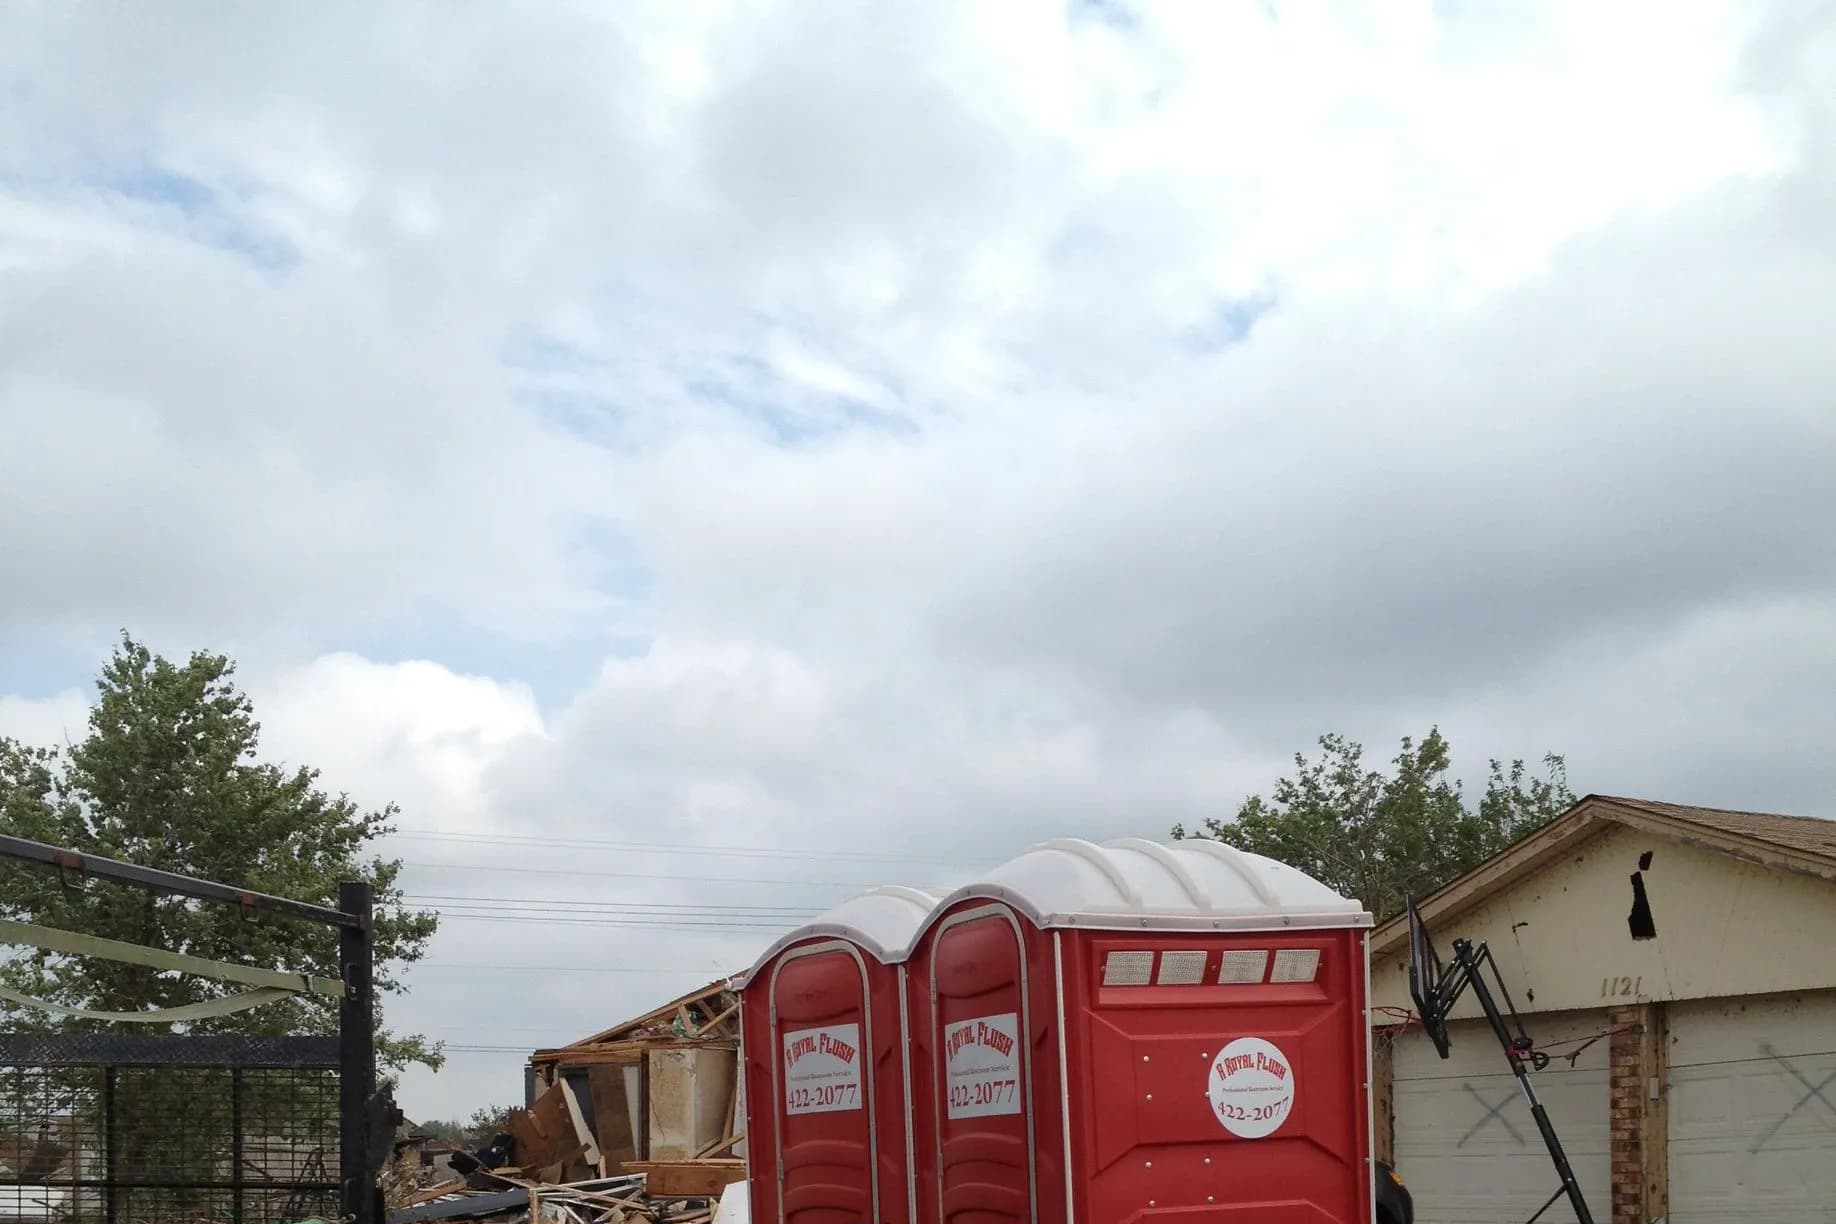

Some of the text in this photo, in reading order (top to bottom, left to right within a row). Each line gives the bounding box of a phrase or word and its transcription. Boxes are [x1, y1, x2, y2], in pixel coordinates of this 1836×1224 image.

[1601, 976, 1642, 998] 1121
[792, 1036, 817, 1063] ROYAL
[819, 1033, 856, 1064] FLUSH
[951, 1025, 975, 1056] ROYAL
[977, 1021, 1014, 1057] FLUSH
[1216, 1051, 1287, 1080] A ROYAL FLUSH
[788, 1083, 857, 1109] 422-2077
[949, 1079, 1016, 1108] 422-2077
[1218, 1095, 1289, 1121] 422-2077
